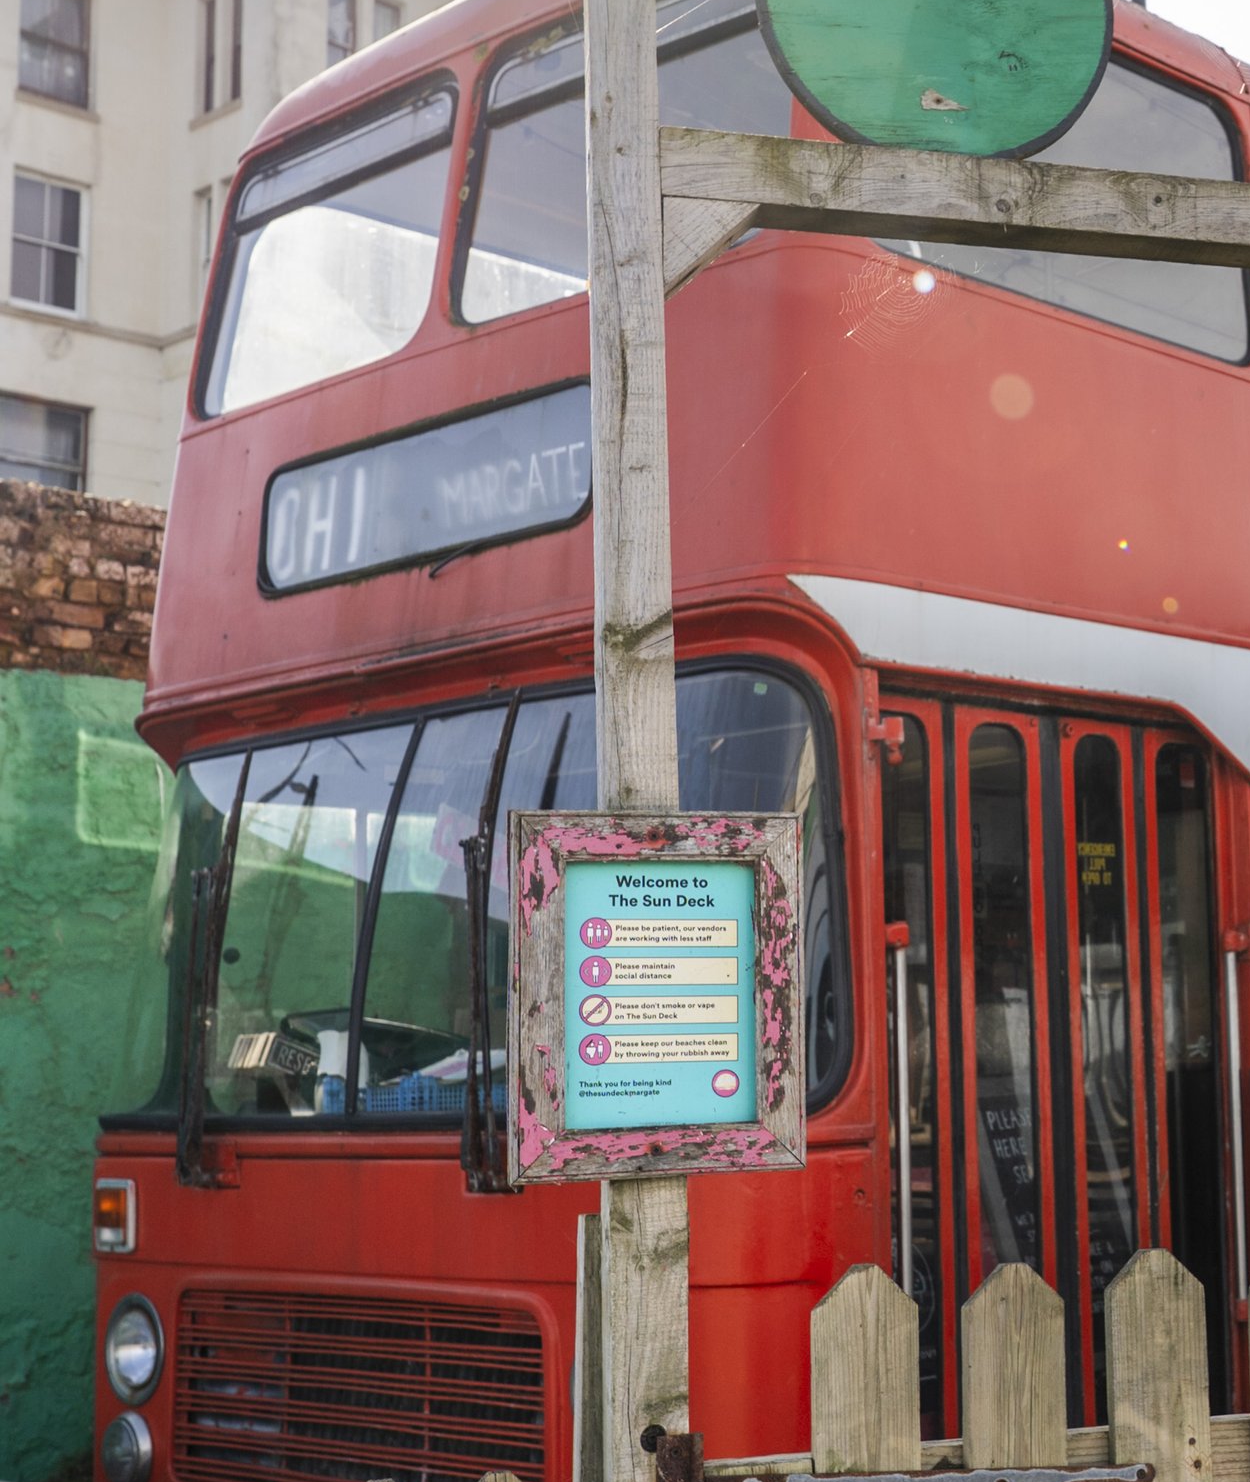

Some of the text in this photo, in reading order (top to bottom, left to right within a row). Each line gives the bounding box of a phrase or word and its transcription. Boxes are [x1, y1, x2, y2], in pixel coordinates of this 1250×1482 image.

[438, 441, 589, 529] MARGATE
[616, 875, 708, 889] Welcome to
[609, 894, 715, 907] The Sun Deck
[652, 925, 681, 934] patient,
[629, 935, 660, 943] working
[641, 1040, 659, 1048] keep
[626, 1051, 660, 1059] throwing
[633, 1080, 653, 1088] being
[579, 1089, 660, 1098] @thesundeckmargate
